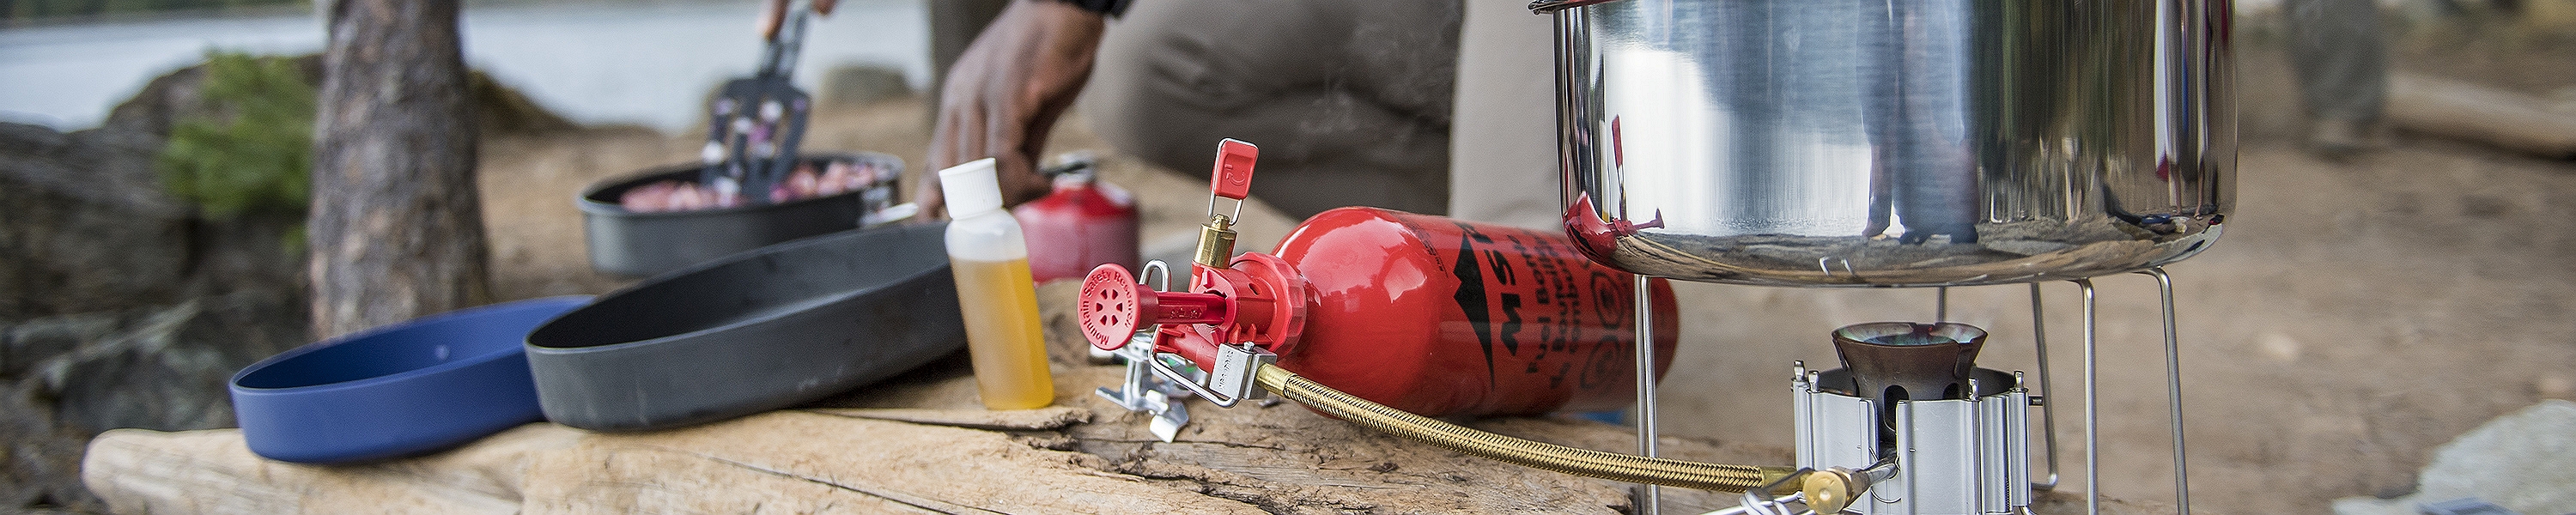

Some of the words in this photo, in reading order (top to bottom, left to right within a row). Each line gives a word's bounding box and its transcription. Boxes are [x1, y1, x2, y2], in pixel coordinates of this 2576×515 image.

[1084, 270, 1111, 298] Safety
[1507, 234, 1550, 305] Bottle
[1080, 300, 1109, 345] Mountain
[1525, 316, 1552, 374] Fuel
